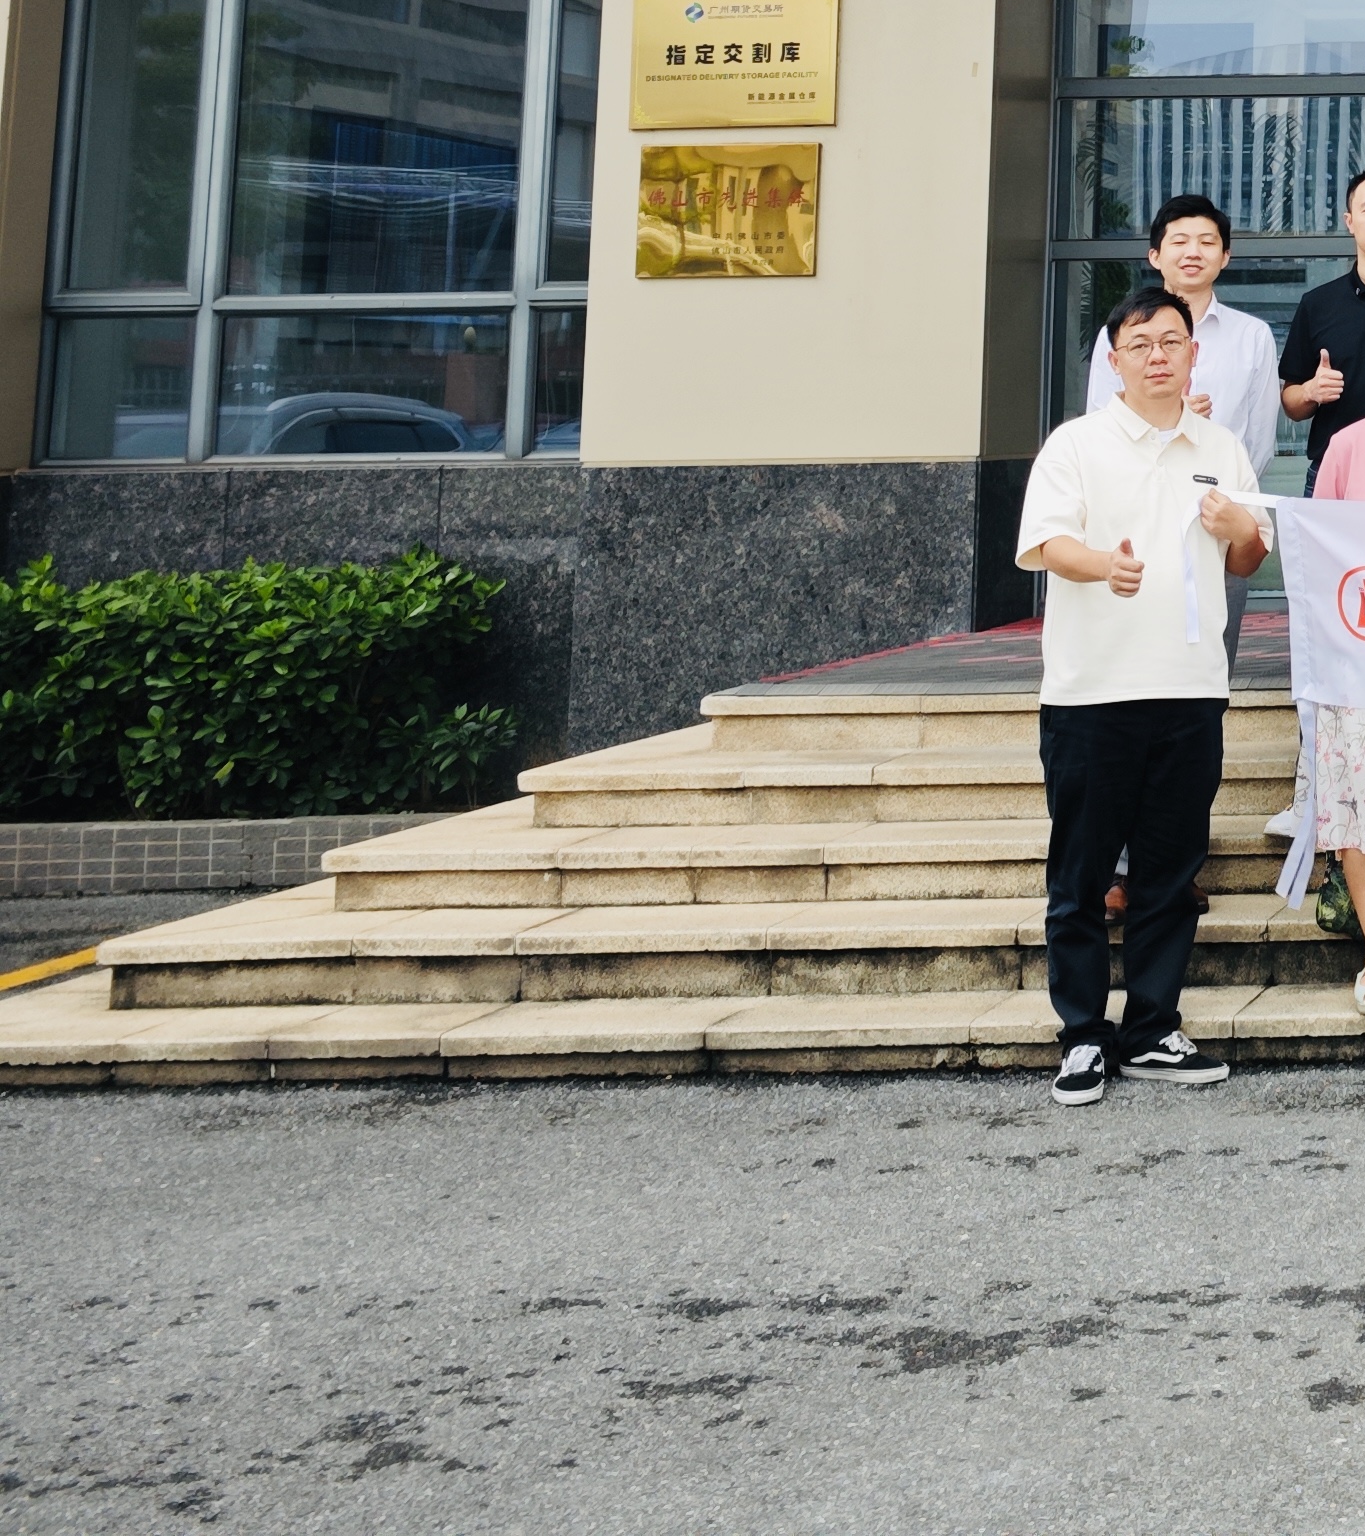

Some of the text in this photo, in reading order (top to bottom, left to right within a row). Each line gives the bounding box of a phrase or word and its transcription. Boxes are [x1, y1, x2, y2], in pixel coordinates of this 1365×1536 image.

[666, 41, 801, 66] 指定交割库
[645, 71, 819, 82] DESIGNATED DELIVERY STORAGE FACILITY
[648, 186, 810, 211] 佛山市先进集体
